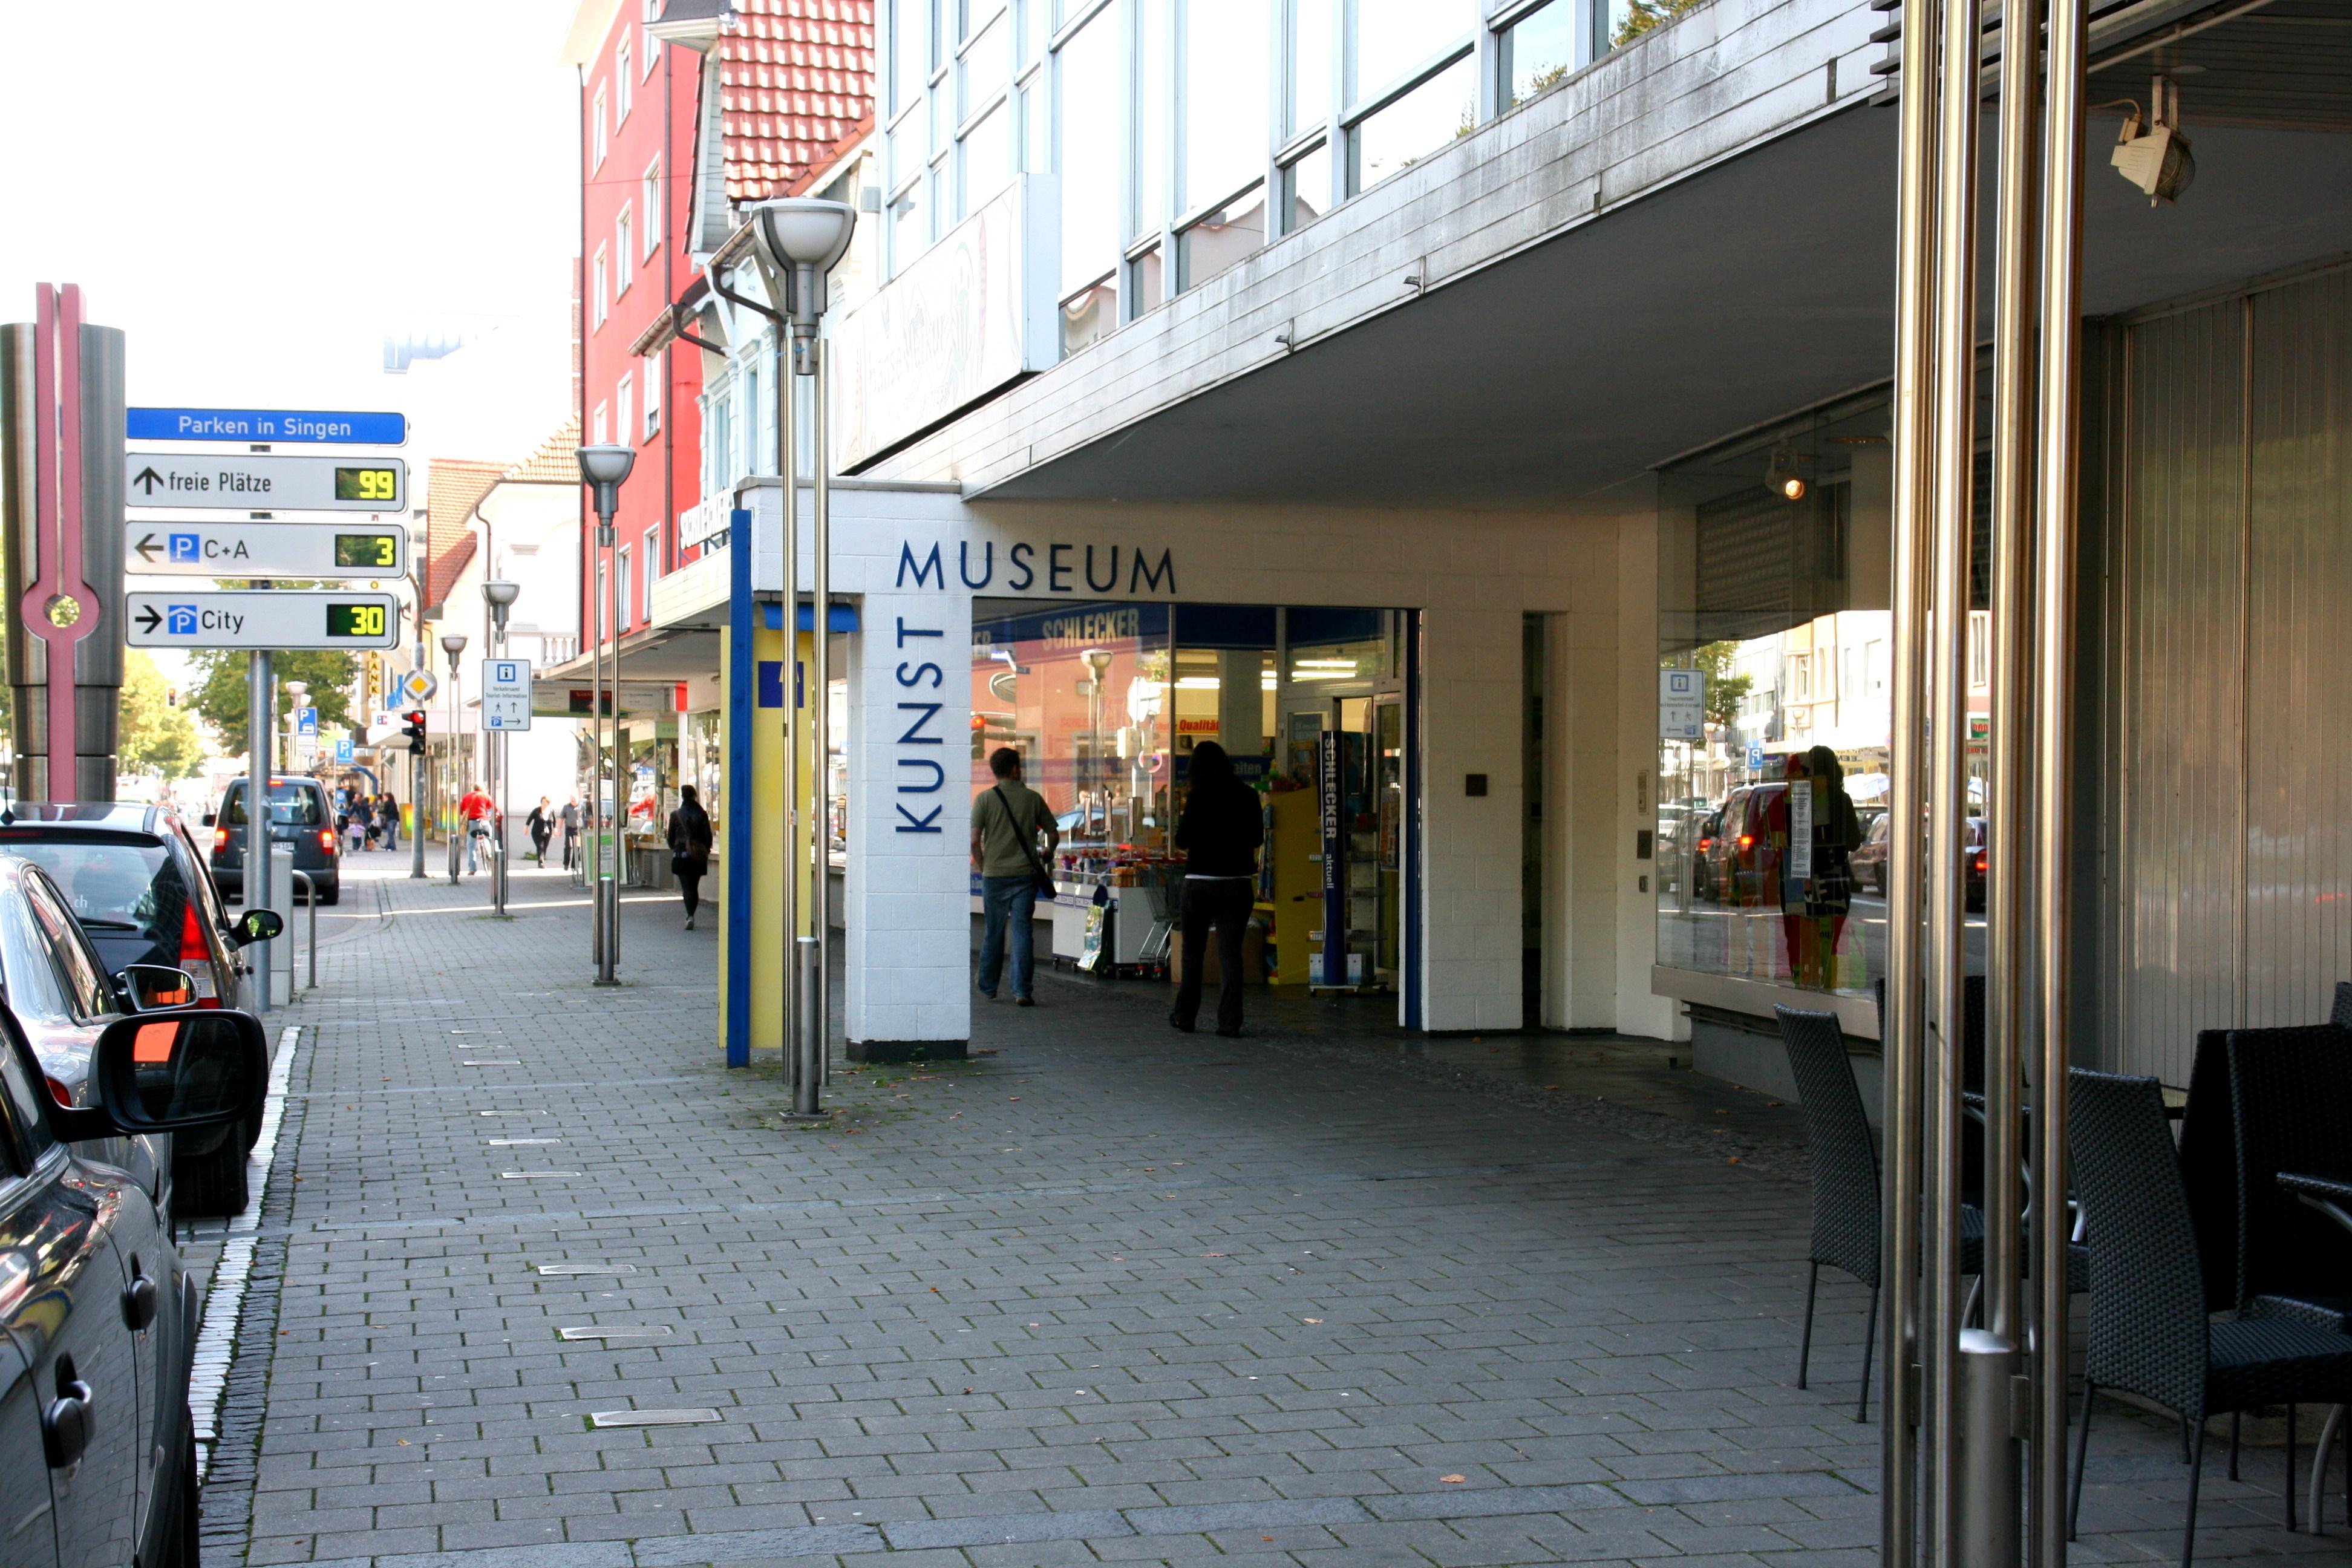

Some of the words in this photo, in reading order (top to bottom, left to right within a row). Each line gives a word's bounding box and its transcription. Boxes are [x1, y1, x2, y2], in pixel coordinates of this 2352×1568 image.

[178, 416, 249, 434] Parken
[257, 417, 274, 435] in
[284, 418, 351, 440] Singen
[169, 471, 210, 492] freie
[219, 472, 272, 492] Plätze
[359, 470, 394, 500] 99
[376, 537, 393, 566] 3
[895, 539, 1176, 594] MUSEUM
[201, 610, 244, 634] City
[350, 606, 384, 635] 30
[1042, 608, 1140, 652] SCHLECKER
[300, 710, 309, 721] P
[895, 616, 944, 833] KUNST
[1325, 738, 1338, 839] SCHLECKER
[1325, 854, 1334, 889] aktuell
